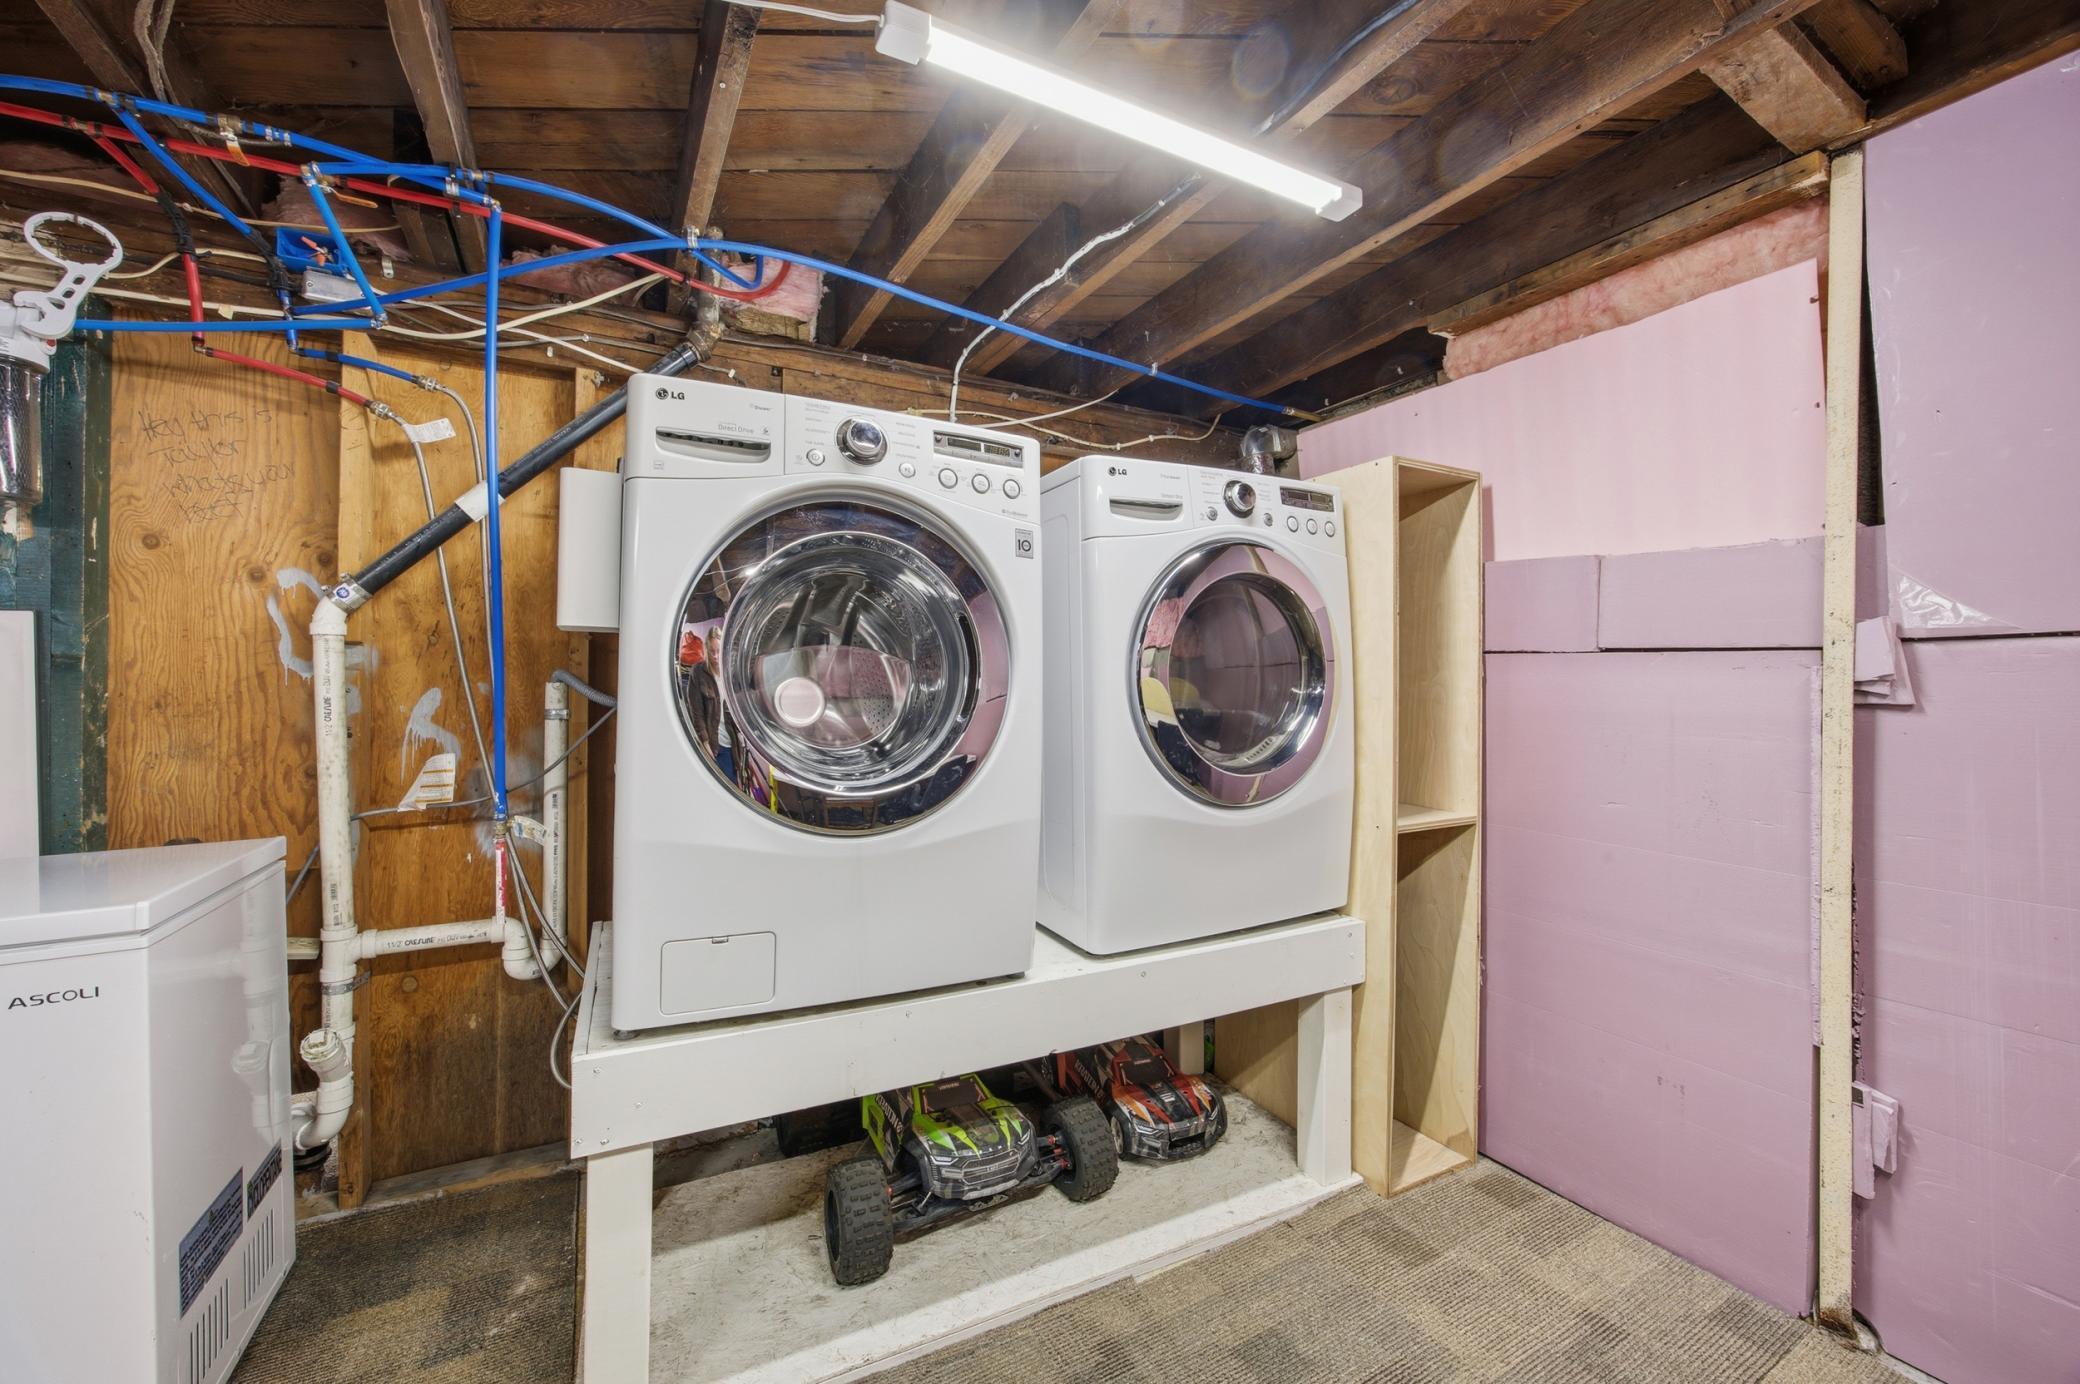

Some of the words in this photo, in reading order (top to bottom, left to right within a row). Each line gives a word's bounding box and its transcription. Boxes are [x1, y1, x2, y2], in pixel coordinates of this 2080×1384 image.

[718, 423, 736, 432] Direct
[1017, 539, 1032, 552] 10
[8, 986, 99, 1010] ASCOLI
